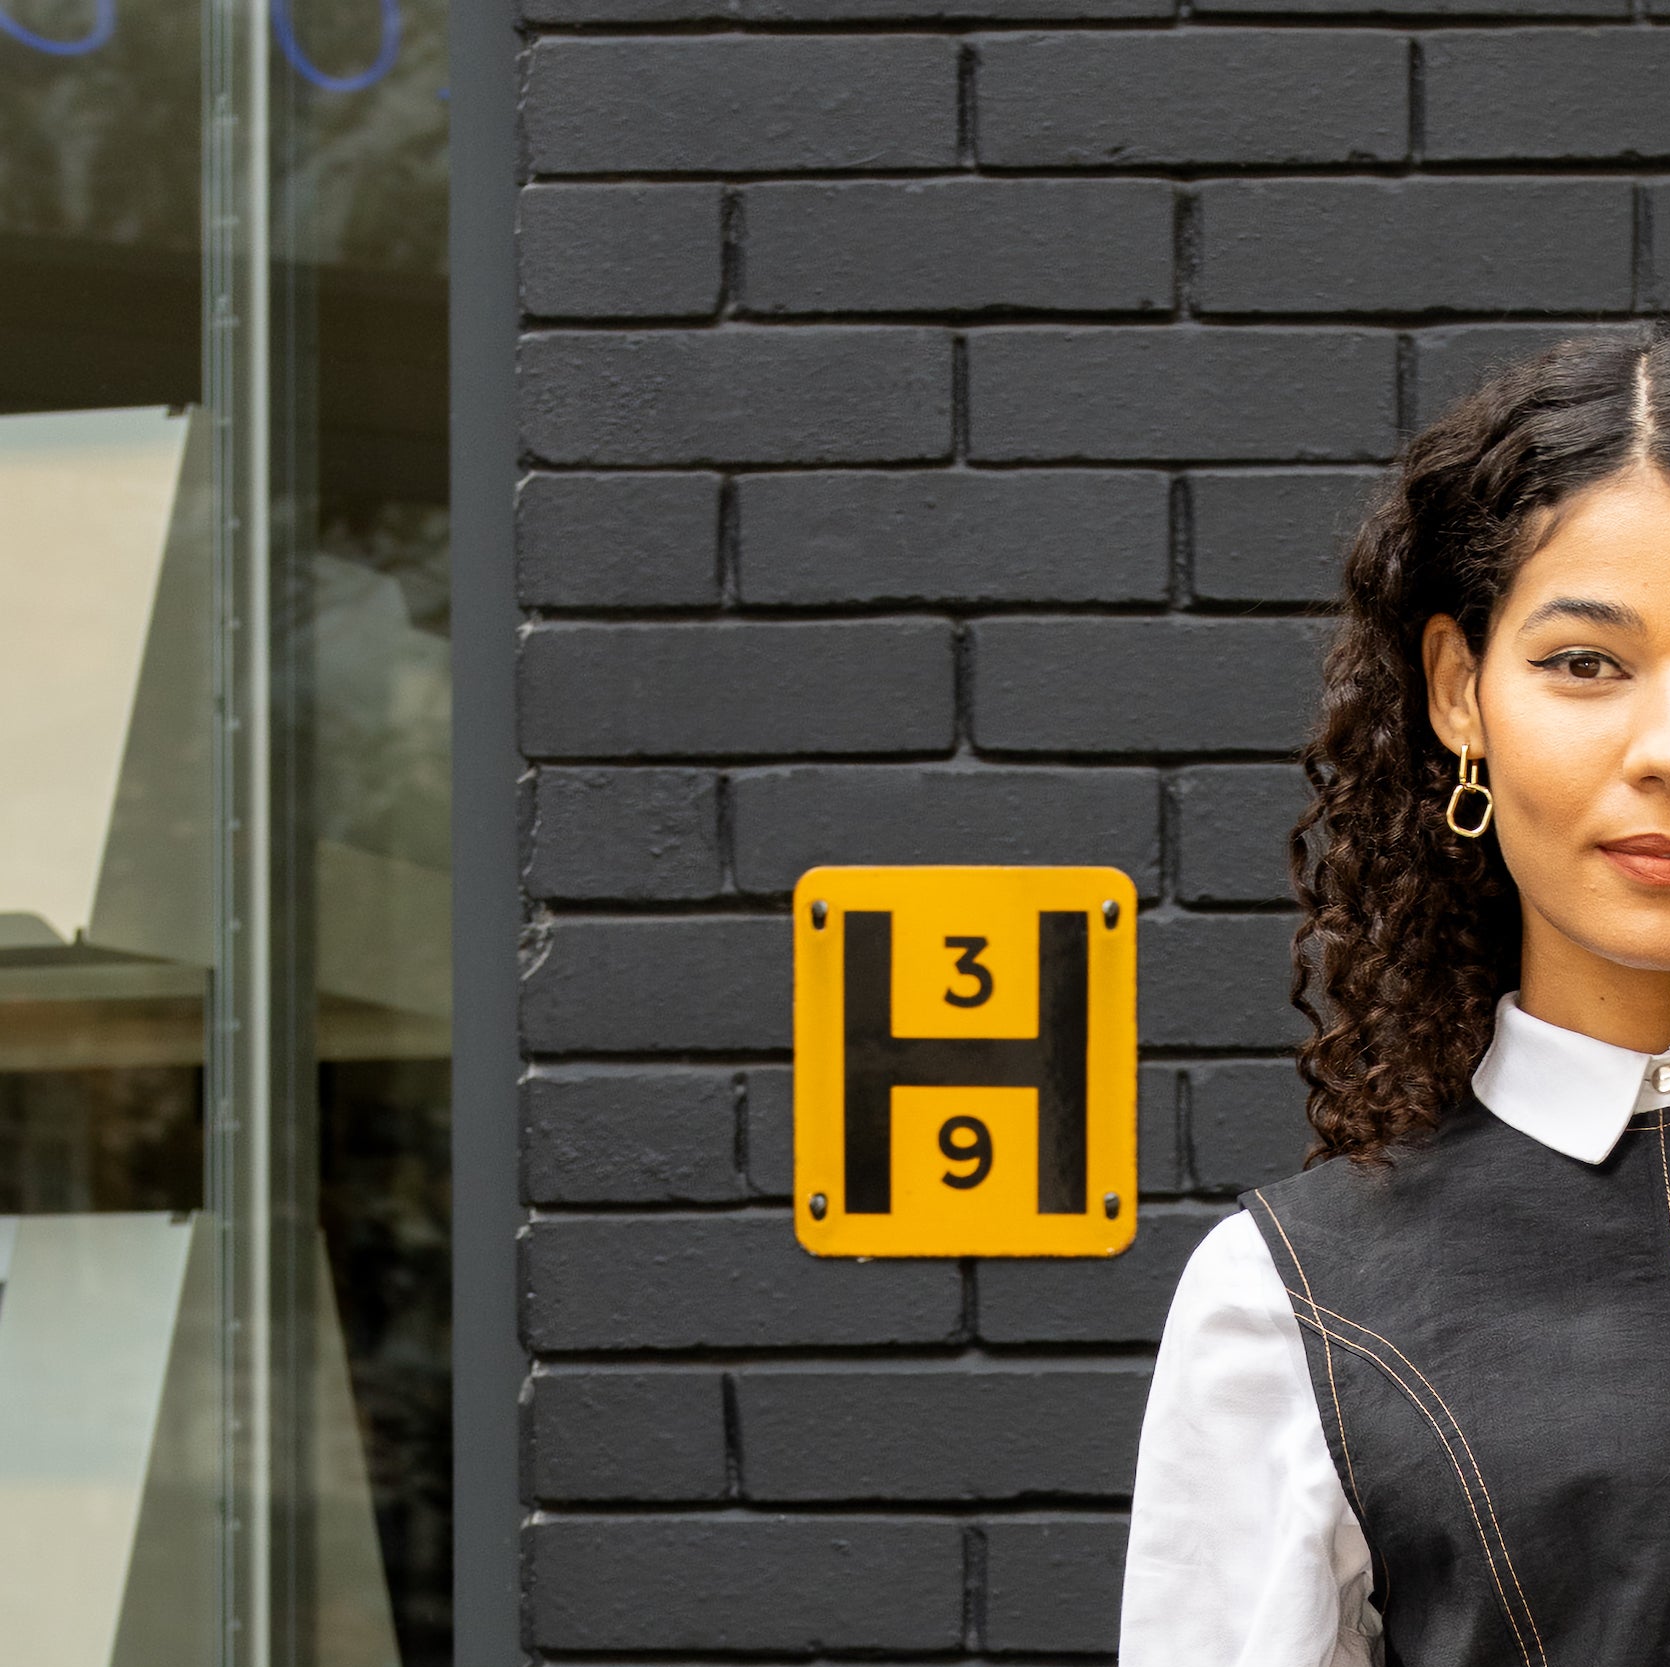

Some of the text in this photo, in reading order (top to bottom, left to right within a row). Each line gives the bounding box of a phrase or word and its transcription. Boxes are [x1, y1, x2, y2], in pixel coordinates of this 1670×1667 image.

[943, 936, 994, 1008] 3
[843, 910, 1089, 1215] H
[938, 1115, 993, 1189] 9
